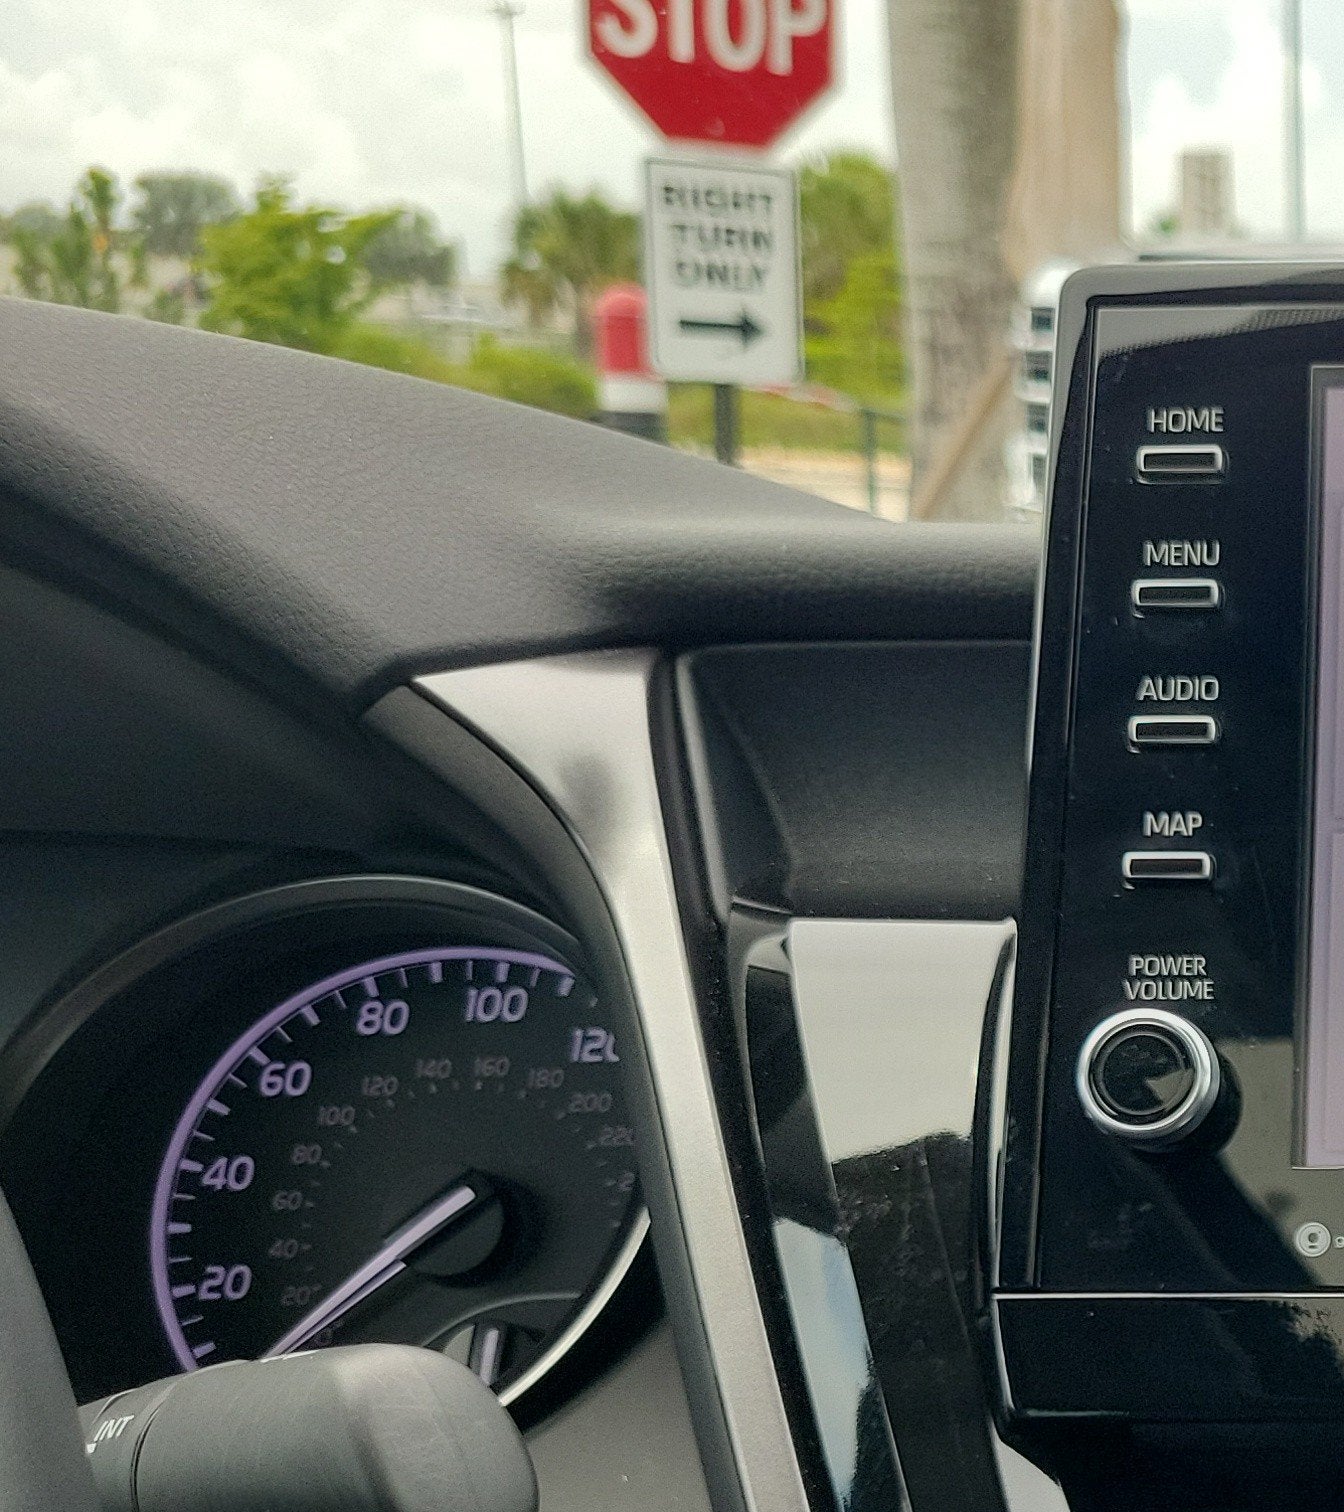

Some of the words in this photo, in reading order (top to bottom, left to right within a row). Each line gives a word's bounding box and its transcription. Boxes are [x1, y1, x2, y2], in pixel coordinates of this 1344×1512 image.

[597, 0, 829, 76] STOP
[662, 184, 773, 212] RIGHT
[672, 223, 773, 253] TURN
[675, 260, 769, 289] ONLY
[1147, 407, 1225, 434] HOME
[1143, 540, 1221, 567] MENU
[1137, 676, 1220, 702] AUDIO
[1143, 811, 1203, 837] MAP
[1128, 954, 1207, 977] POWER
[1123, 979, 1215, 1001] VOLUME
[356, 1000, 410, 1035] 80
[465, 986, 528, 1024] 100
[259, 1061, 312, 1096] 60
[415, 1058, 452, 1079] 140
[473, 1056, 511, 1078] 160
[527, 1067, 564, 1088] 180
[362, 1076, 399, 1096] 120
[317, 1105, 355, 1127] 100
[291, 1145, 323, 1165] 80
[202, 1156, 254, 1191] 40
[273, 1191, 302, 1211] 60
[199, 1265, 251, 1299] 20
[93, 1415, 134, 1443] INT
